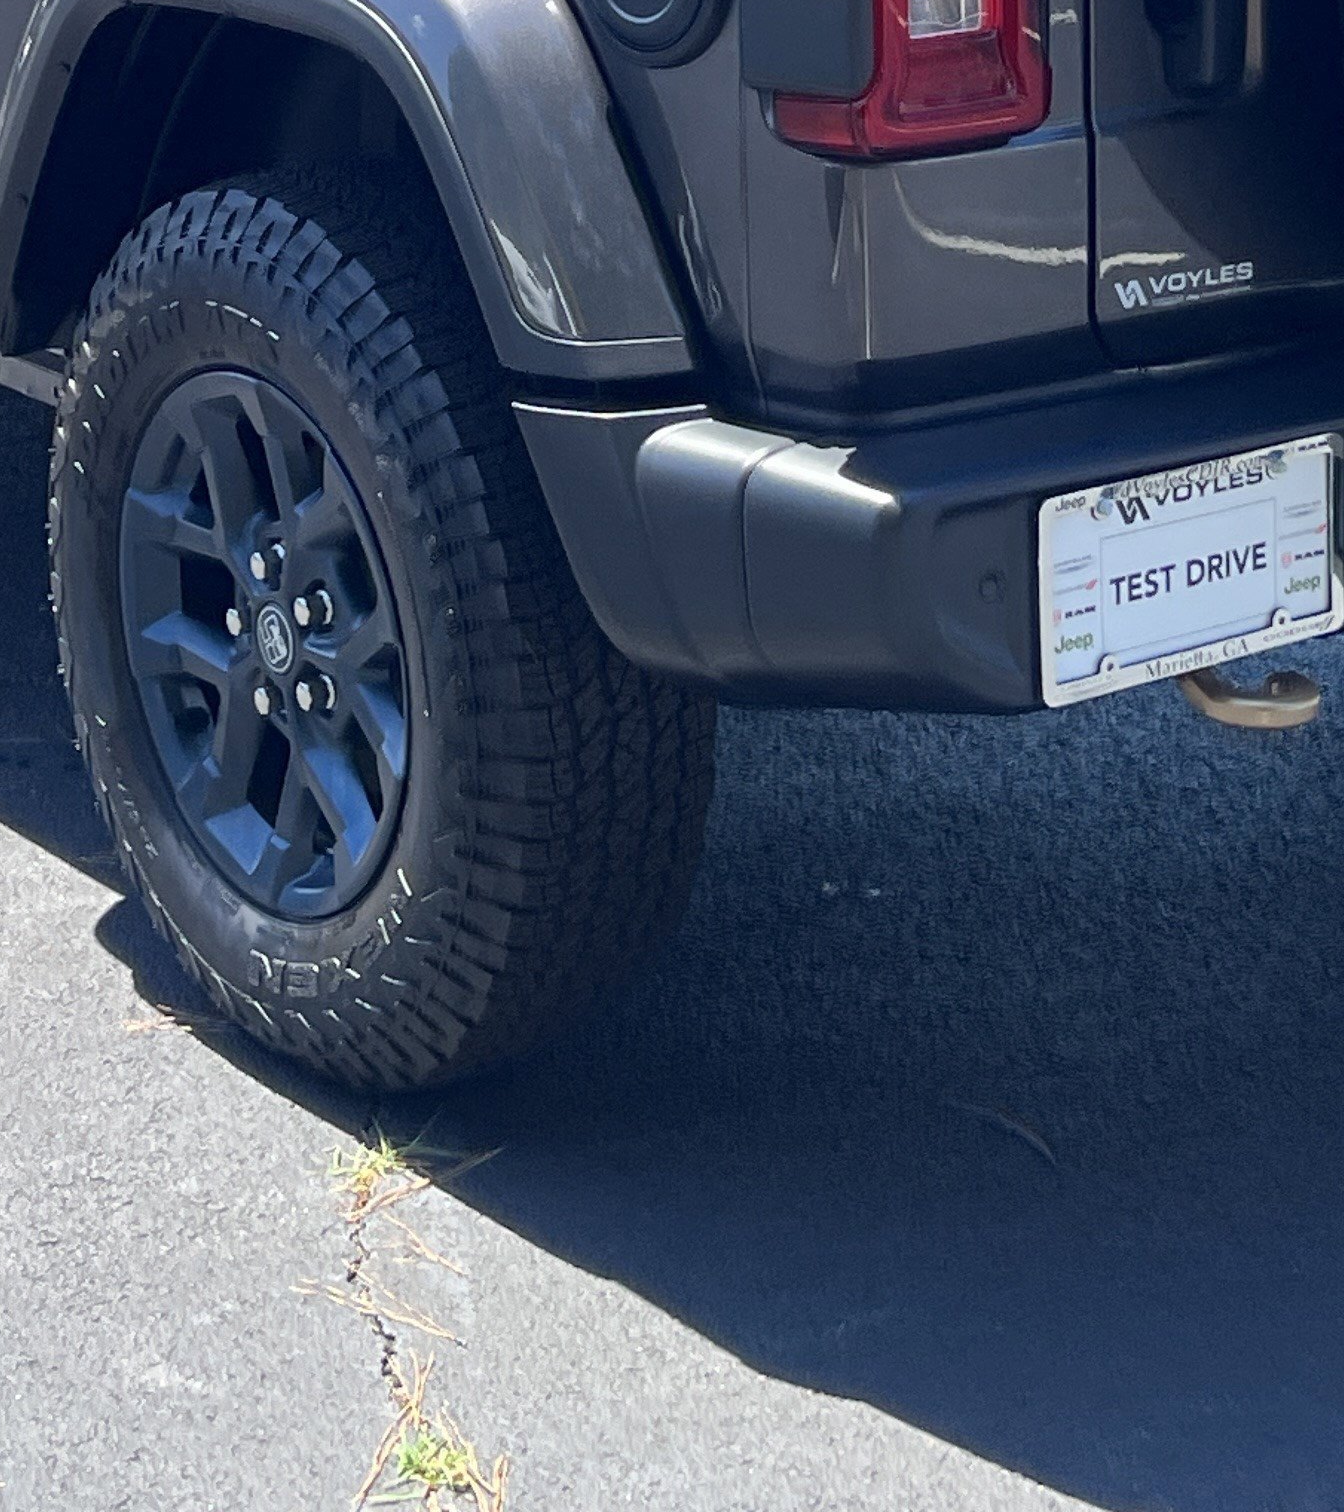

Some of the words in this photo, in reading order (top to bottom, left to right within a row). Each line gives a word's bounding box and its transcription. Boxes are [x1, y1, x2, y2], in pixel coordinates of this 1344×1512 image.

[1148, 261, 1254, 294] VOYLES
[1155, 466, 1263, 506] VOYLES
[1055, 496, 1086, 513] Jeep
[1109, 563, 1177, 606] TEST
[1186, 541, 1268, 588] DRIVE
[1283, 575, 1321, 595] Jeep
[1054, 632, 1094, 654] Jeep
[1222, 638, 1250, 658] GA
